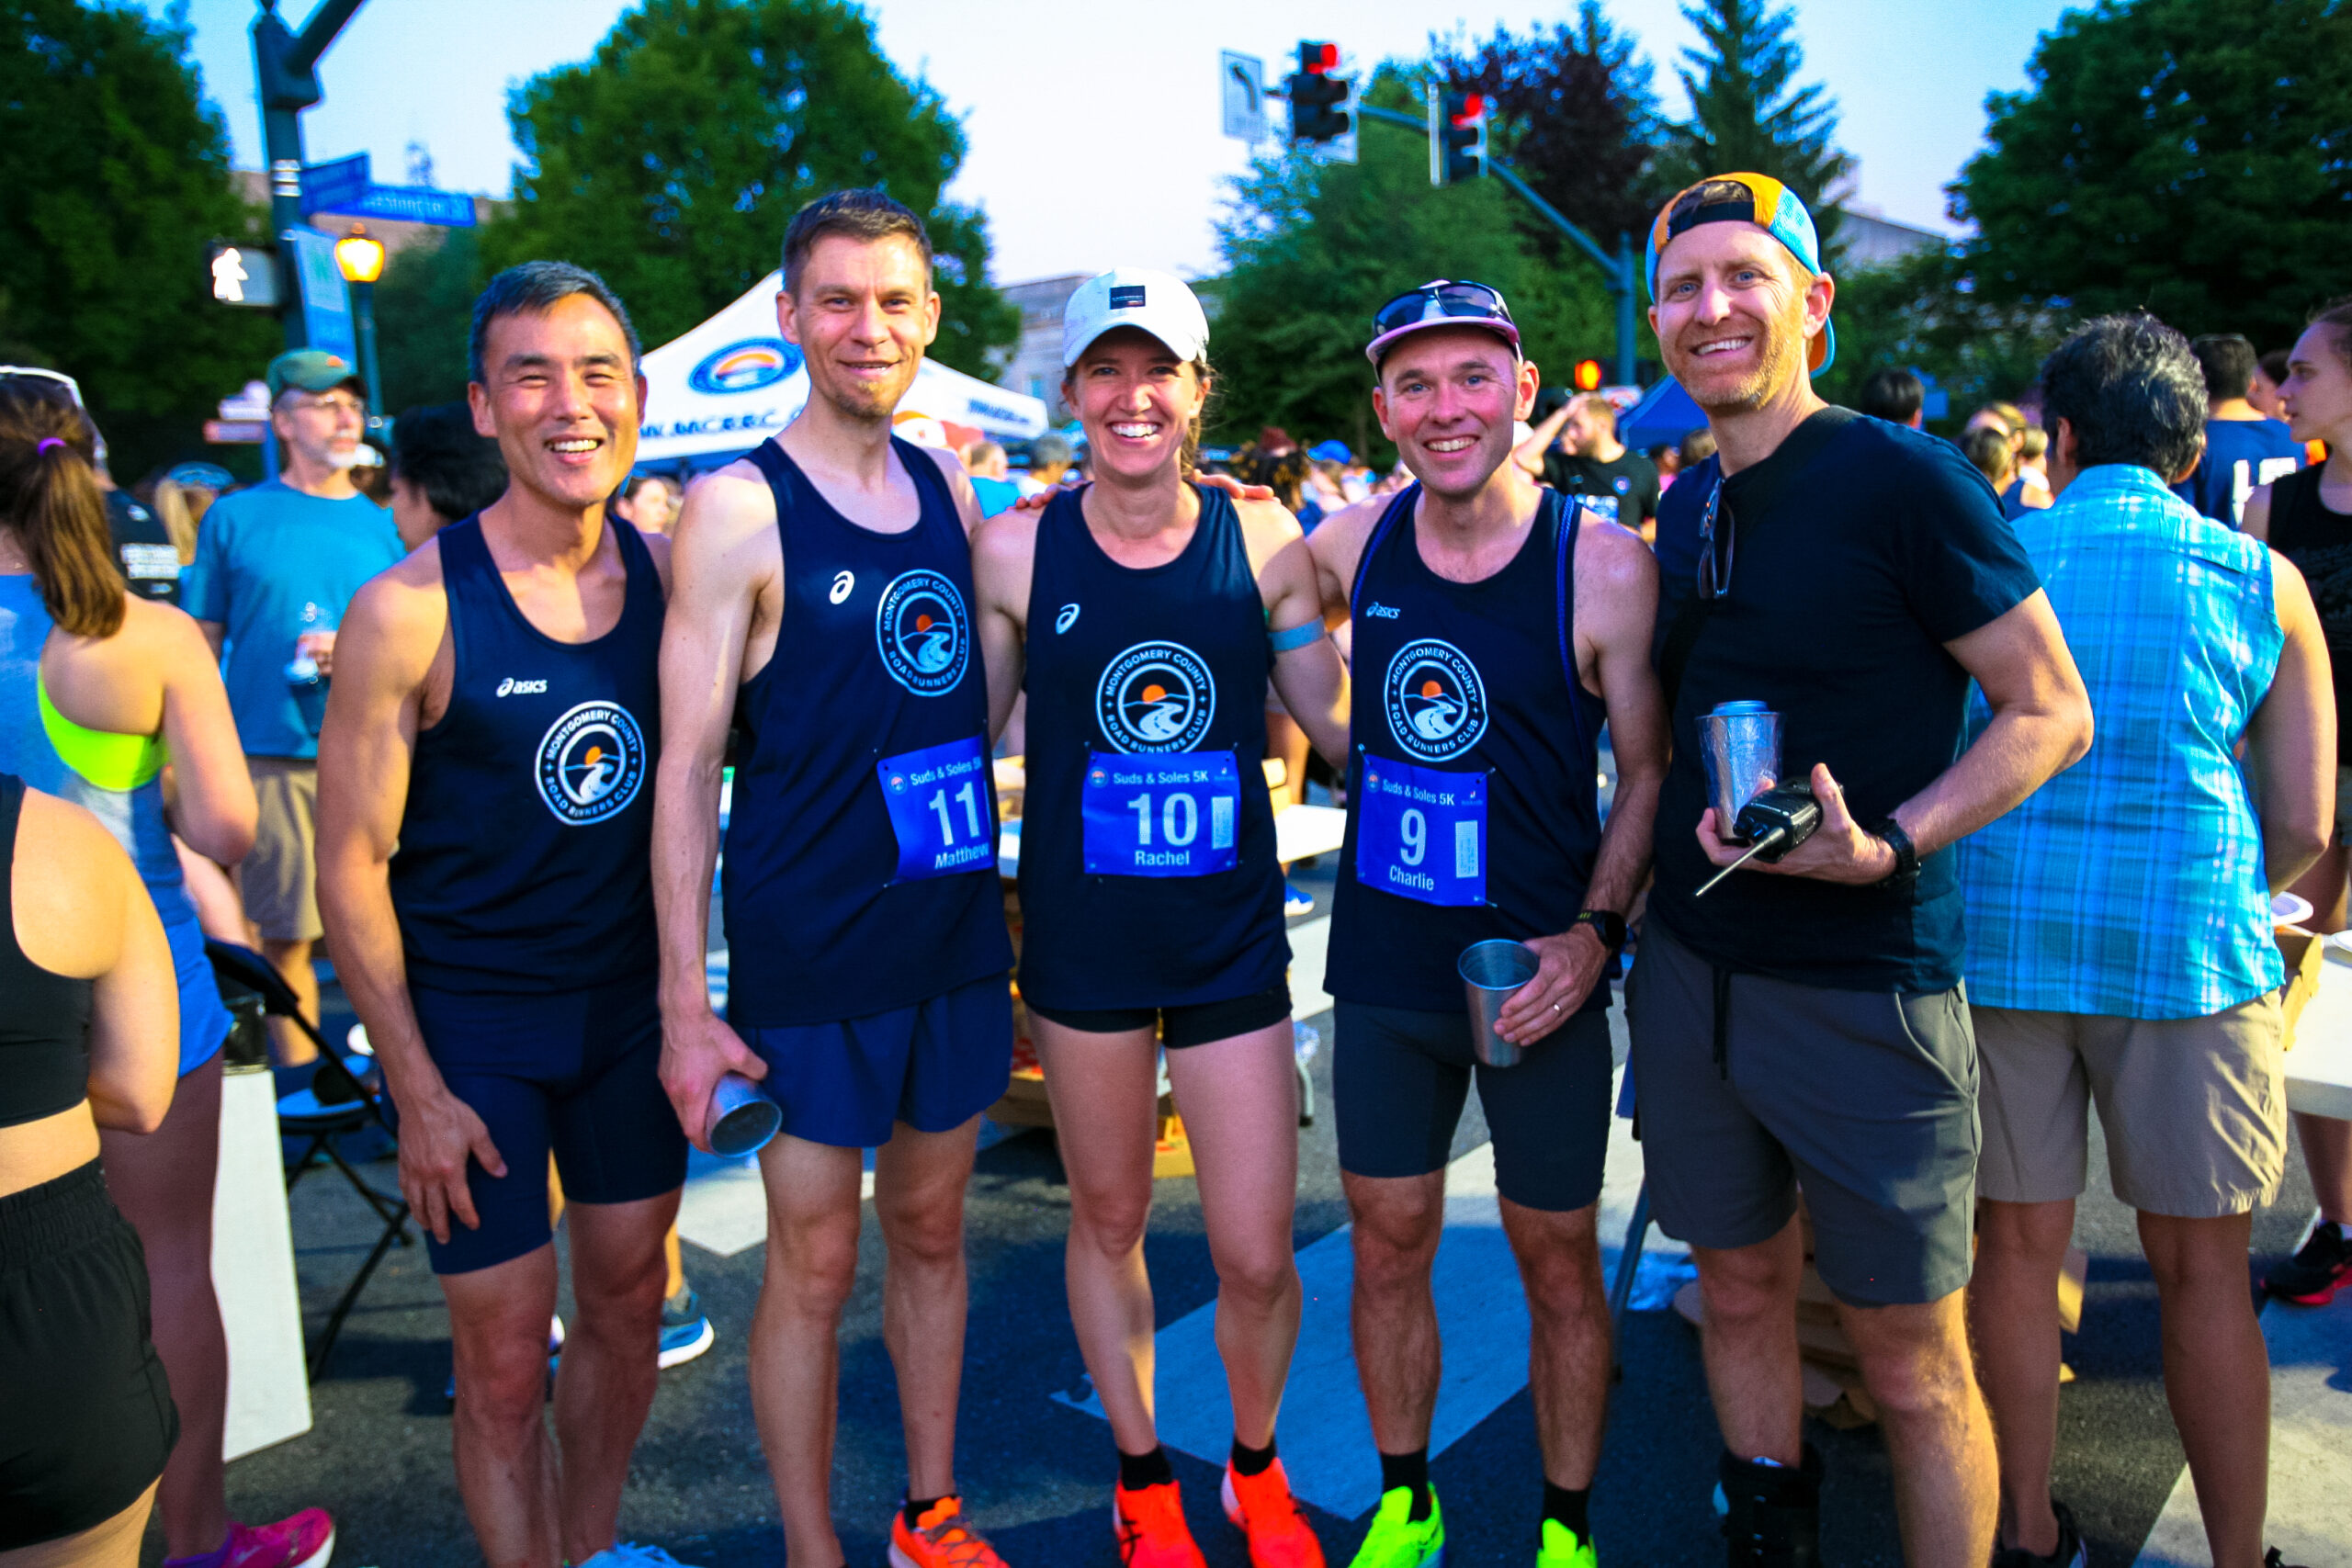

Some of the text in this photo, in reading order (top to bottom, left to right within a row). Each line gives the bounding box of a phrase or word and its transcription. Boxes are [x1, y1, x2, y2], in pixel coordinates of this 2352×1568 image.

[883, 577, 964, 632] MONTGOMERY COUNTY
[888, 650, 913, 680] ROAD
[912, 667, 957, 688] RUNNERS
[1104, 648, 1208, 697] MONTGOMERY COUNTY
[1391, 647, 1479, 703] MONTGOMERY COUNTY
[545, 709, 639, 761] MONTGOMERY COUNTY
[1105, 708, 1207, 753] ROAD RUNNERS CLUB
[1390, 703, 1479, 754] ROAD RUNNERS CLUB
[545, 771, 638, 818] ROAD RUNNERS CLUB
[910, 771, 935, 785] Suds
[937, 766, 944, 779] &
[945, 761, 972, 775] Soles
[1114, 773, 1142, 784] Suds
[1146, 772, 1156, 784] &
[1159, 771, 1190, 784] Soles
[1193, 770, 1209, 783] 5K
[1383, 779, 1455, 806] Suds & Soles 5K
[928, 781, 981, 846] 11
[1126, 792, 1198, 847] 10
[1400, 807, 1427, 866] 9
[935, 842, 989, 869] Matthew
[1134, 850, 1190, 866] Rachel
[1389, 865, 1434, 891] Charlie
